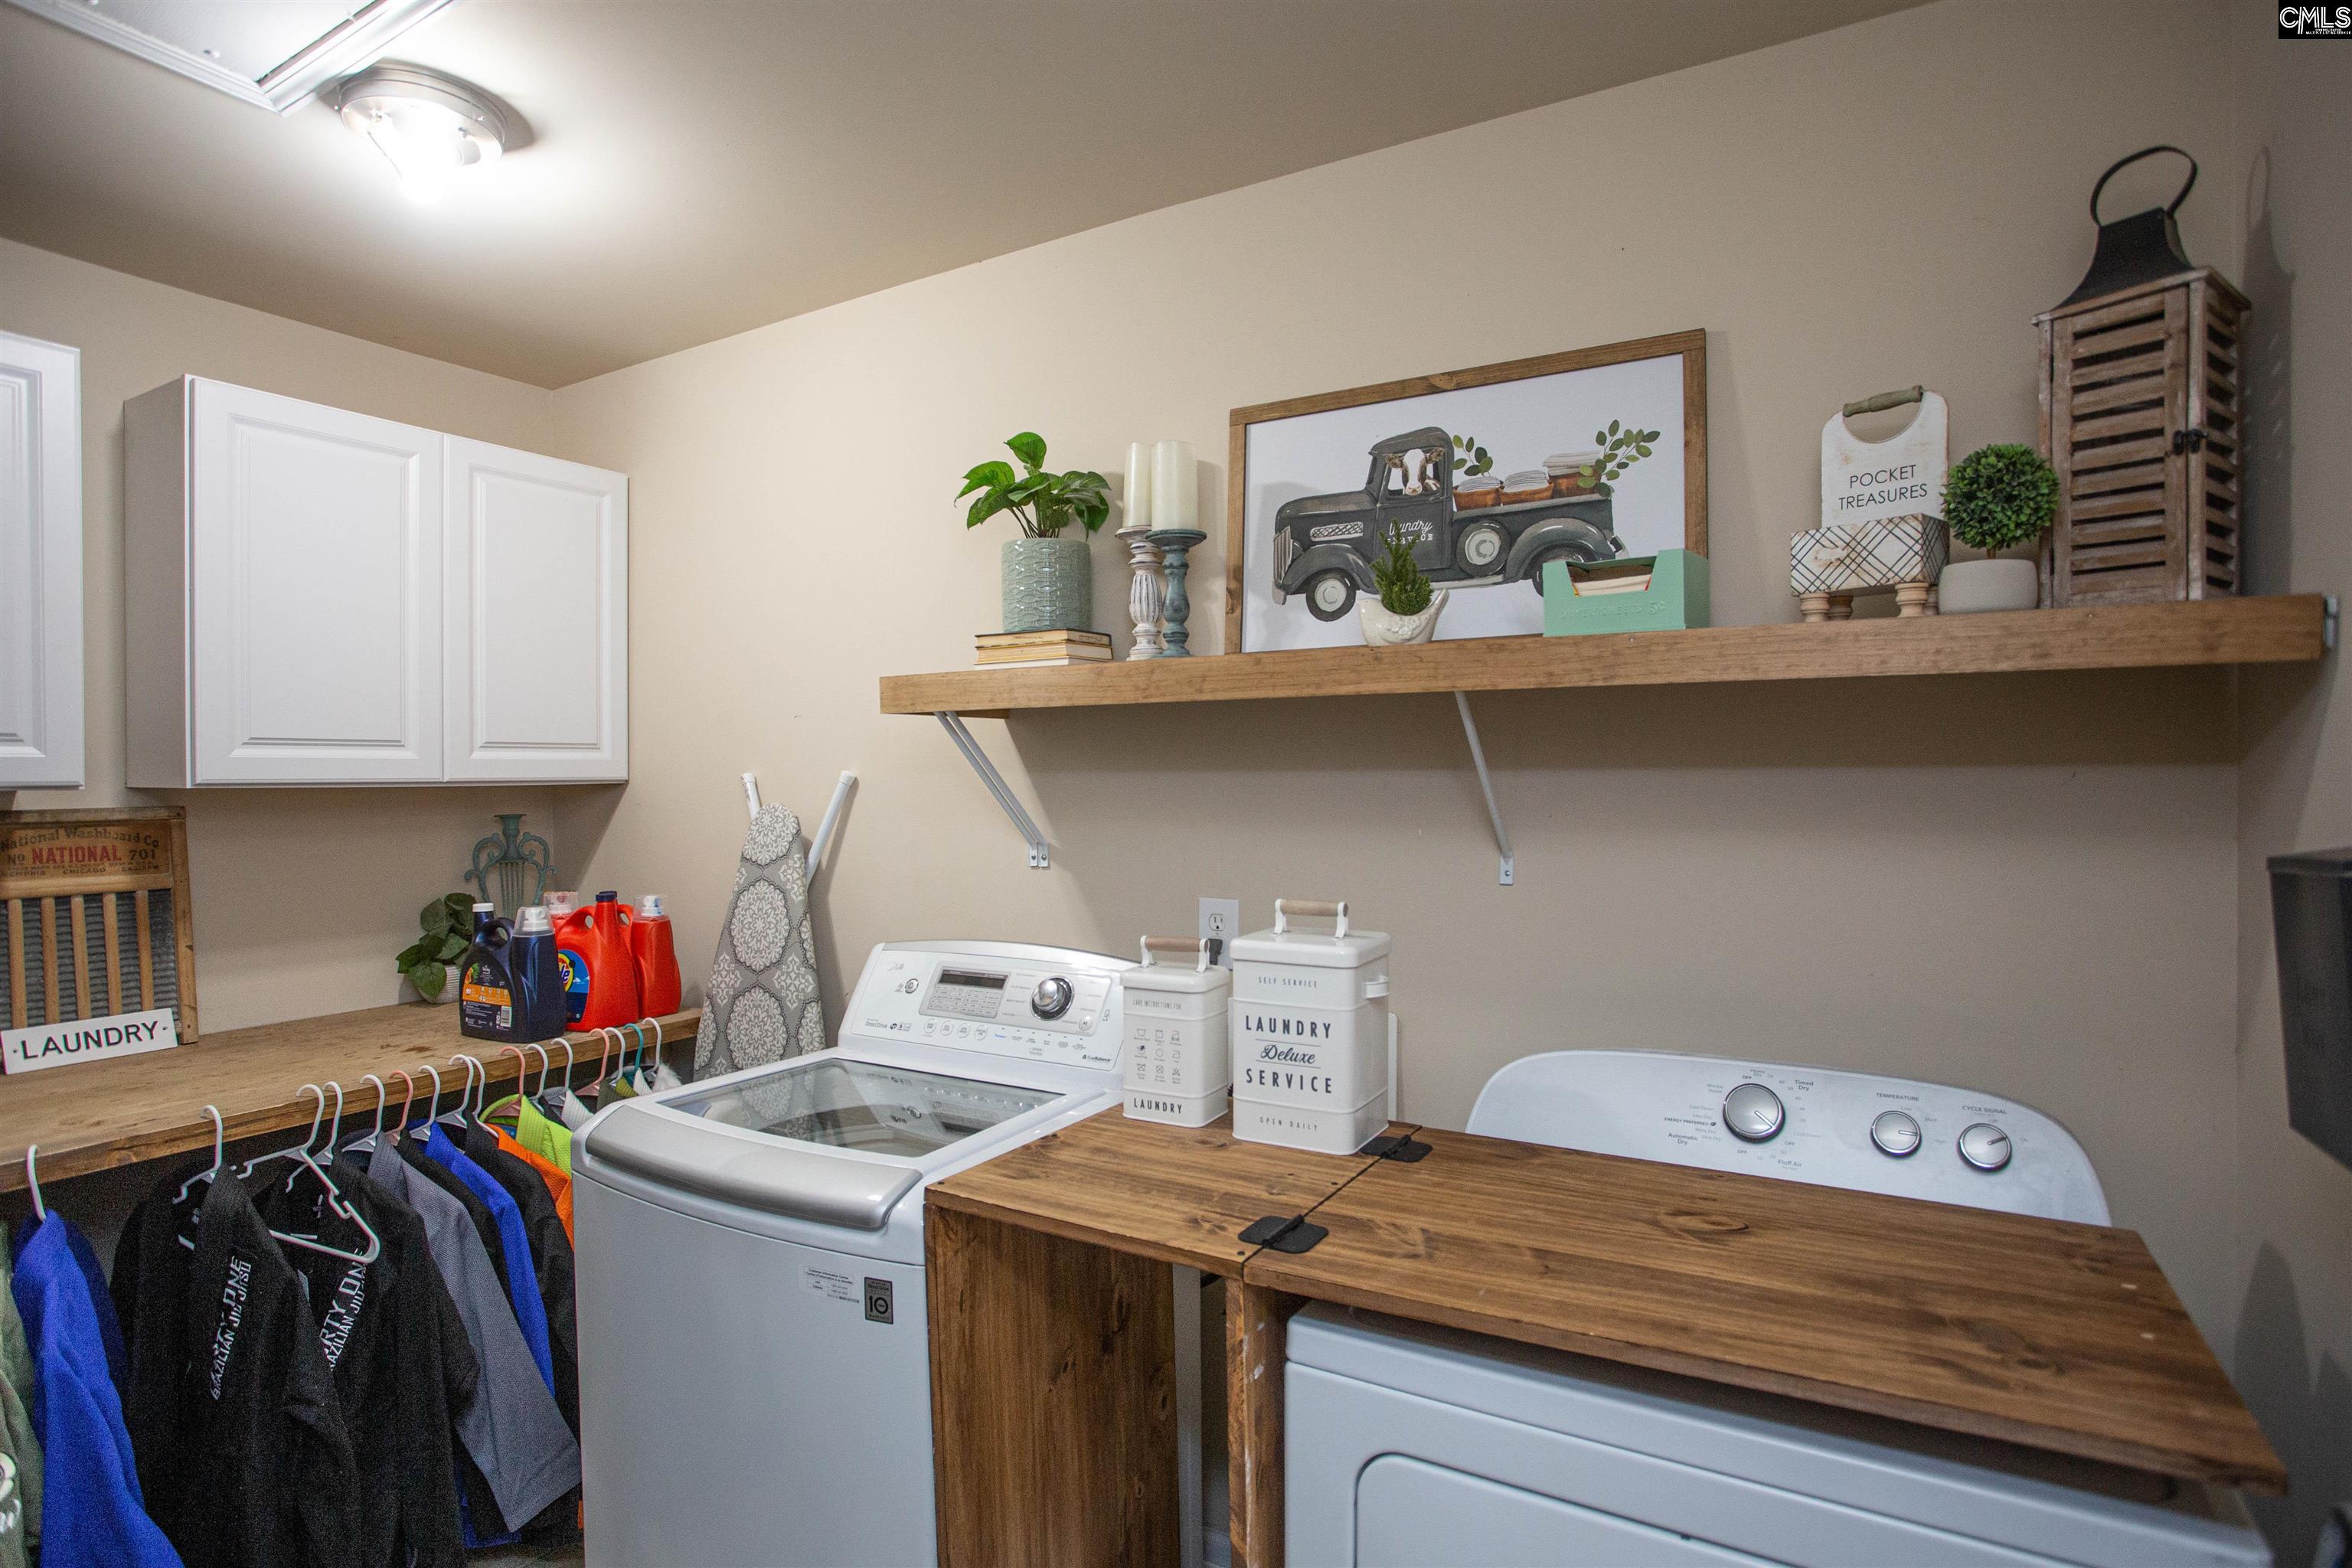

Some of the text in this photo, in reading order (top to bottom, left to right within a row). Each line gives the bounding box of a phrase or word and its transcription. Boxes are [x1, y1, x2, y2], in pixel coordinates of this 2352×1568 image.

[1849, 464, 1917, 488] POCKET
[1838, 483, 1928, 510] TREASURES
[32, 844, 122, 865] NATIONAL
[129, 849, 156, 861] 701
[63, 867, 106, 875] CHICAGO
[1257, 976, 1318, 988] SELF SERVICE
[1245, 1014, 1331, 1039] LAUNDRY
[21, 1021, 158, 1060] LAUNDRY
[1259, 1044, 1316, 1065] Deluxe
[1245, 1067, 1333, 1094] SERVICE
[1133, 1097, 1183, 1115] LAUNDRY
[1876, 1093, 1919, 1102] TEMPERATURE
[1983, 1106, 2007, 1115] SIGNAL
[1259, 1116, 1318, 1132] OPEN DAILY
[1668, 1132, 1699, 1142] Automatic
[868, 1295, 889, 1315] 10
[326, 1289, 366, 1372] AZILIAN JIU
[210, 1328, 236, 1400] BRAZILIAN
[228, 1304, 243, 1327] JIU
